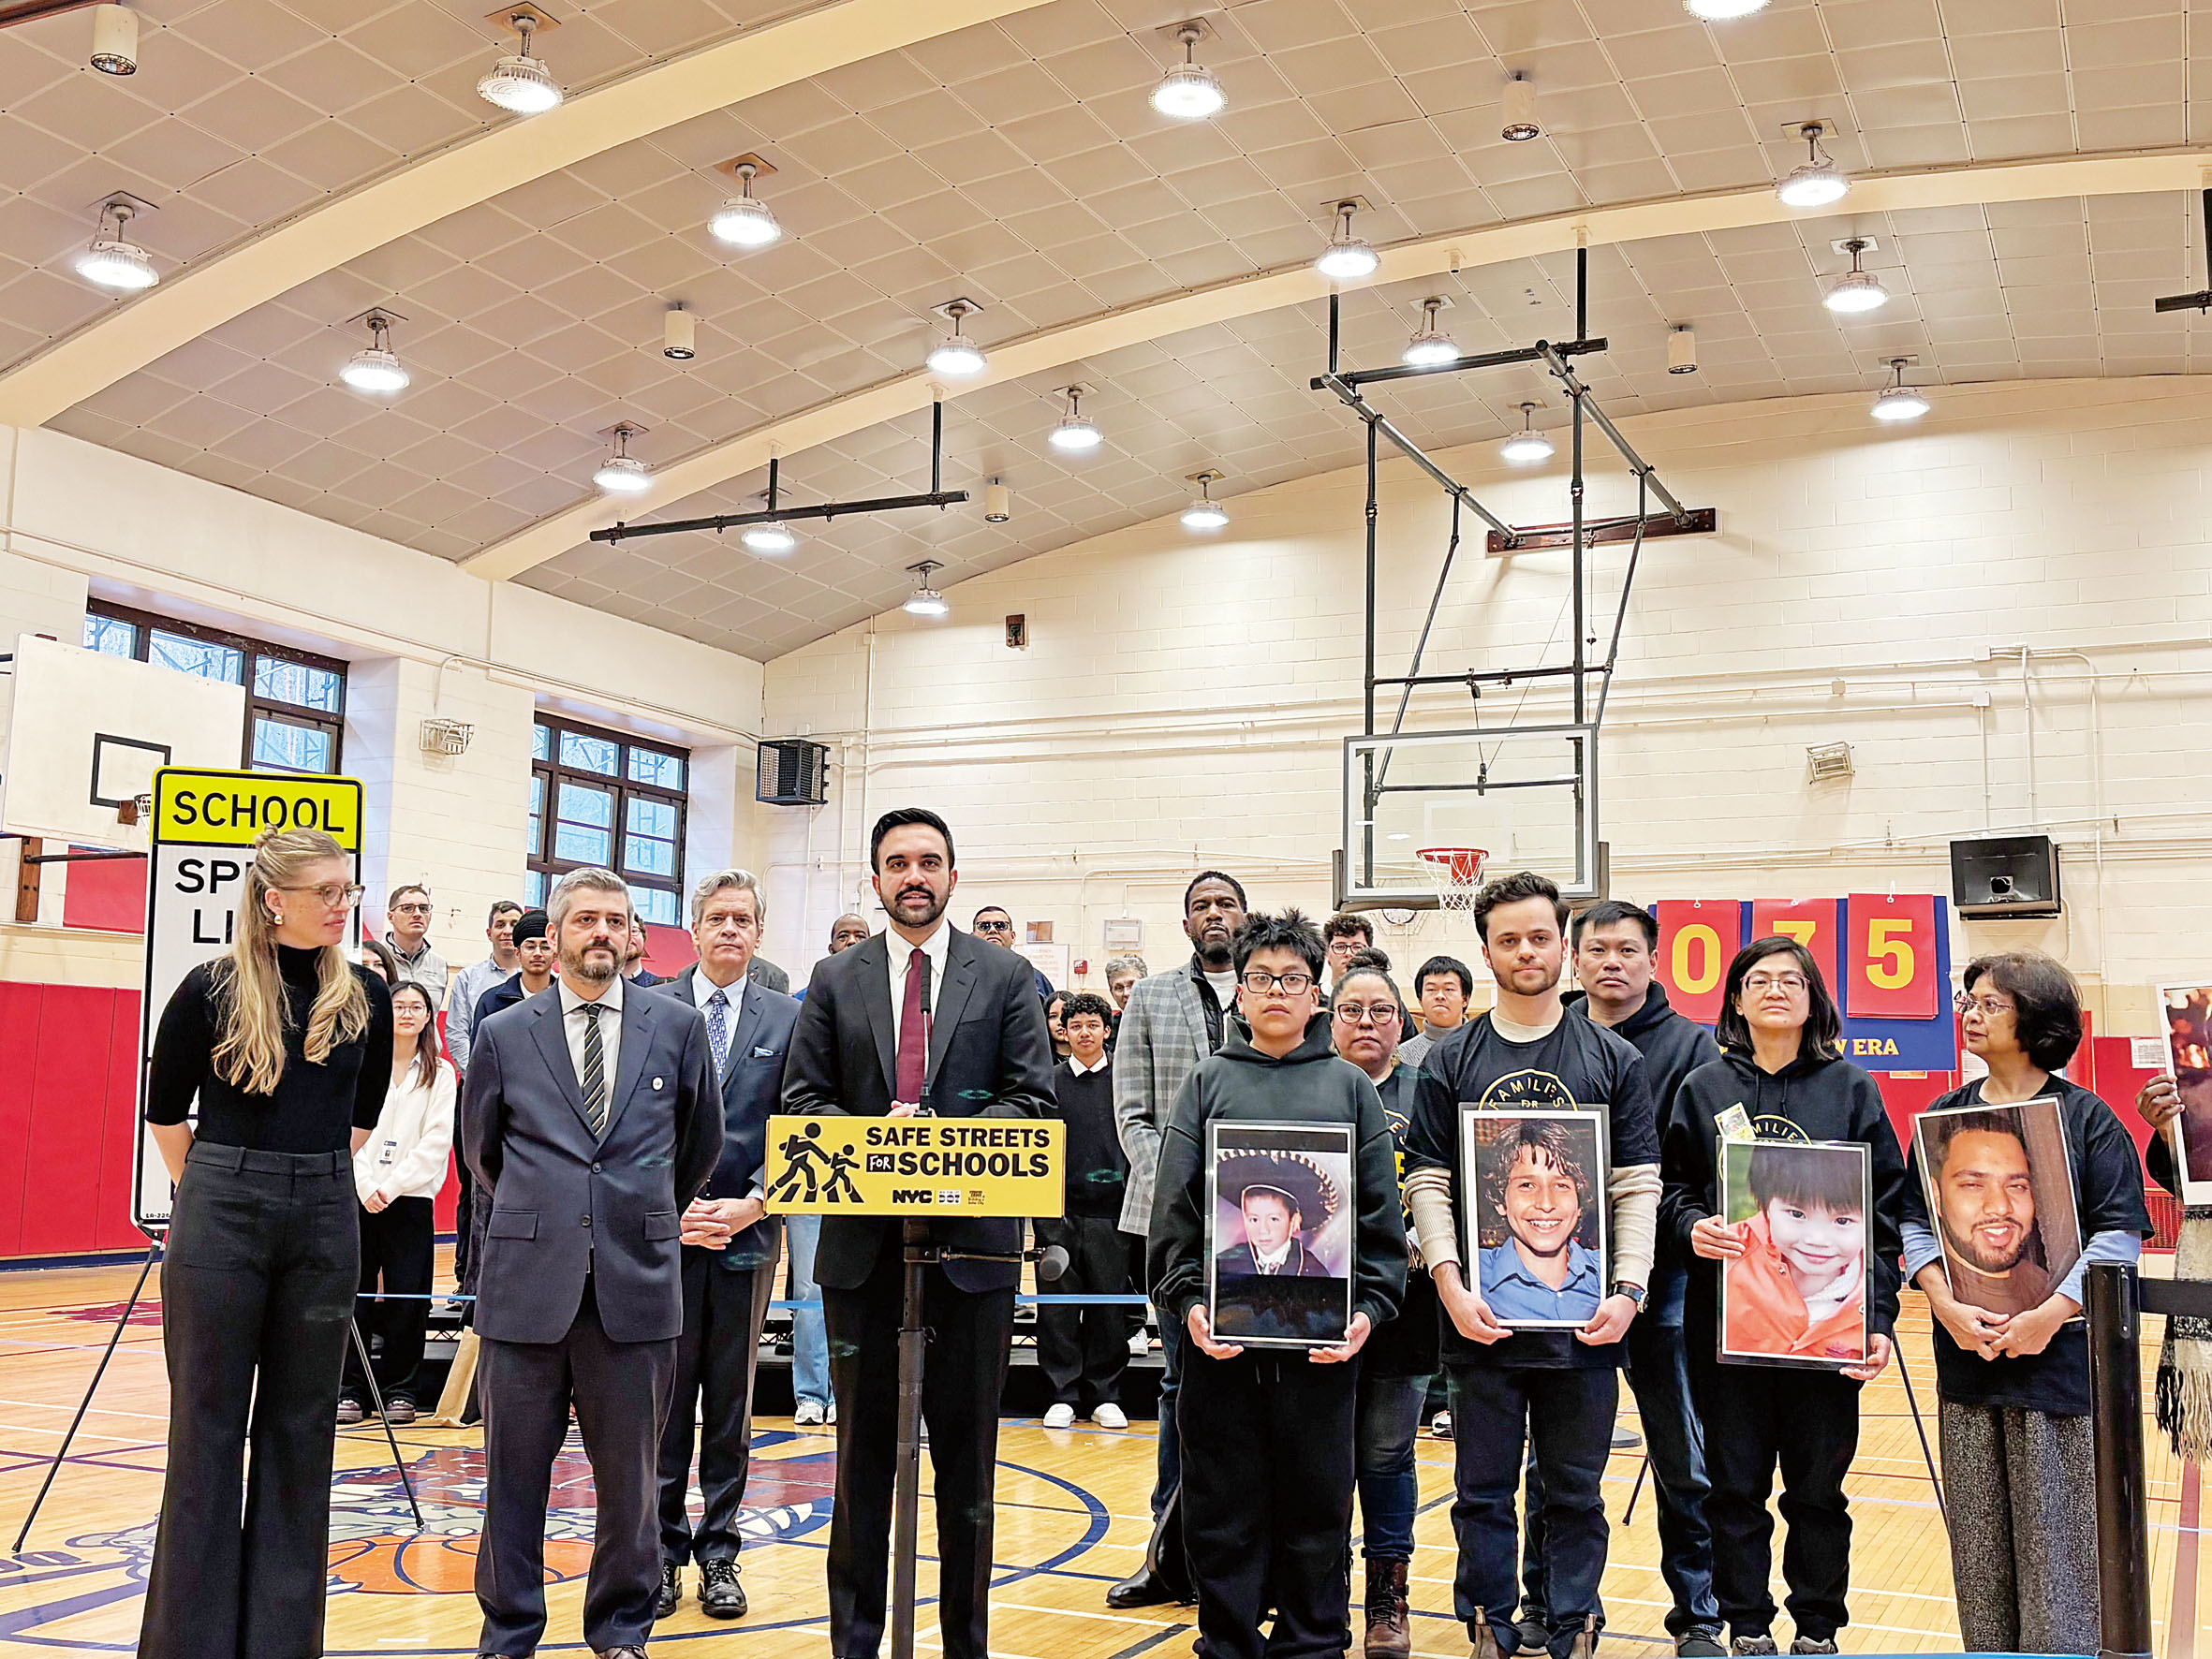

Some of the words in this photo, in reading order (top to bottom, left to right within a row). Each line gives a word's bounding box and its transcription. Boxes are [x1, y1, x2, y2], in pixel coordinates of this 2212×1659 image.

[172, 790, 345, 833] SCHOOL
[174, 859, 255, 894] SP
[1852, 1038, 1899, 1056] ERA
[865, 1126, 931, 1147] SAFE
[939, 1127, 1050, 1148] STREETS
[869, 1154, 892, 1171] FOR
[897, 1152, 1050, 1178] SCHOOLS
[892, 1189, 933, 1204] NYC
